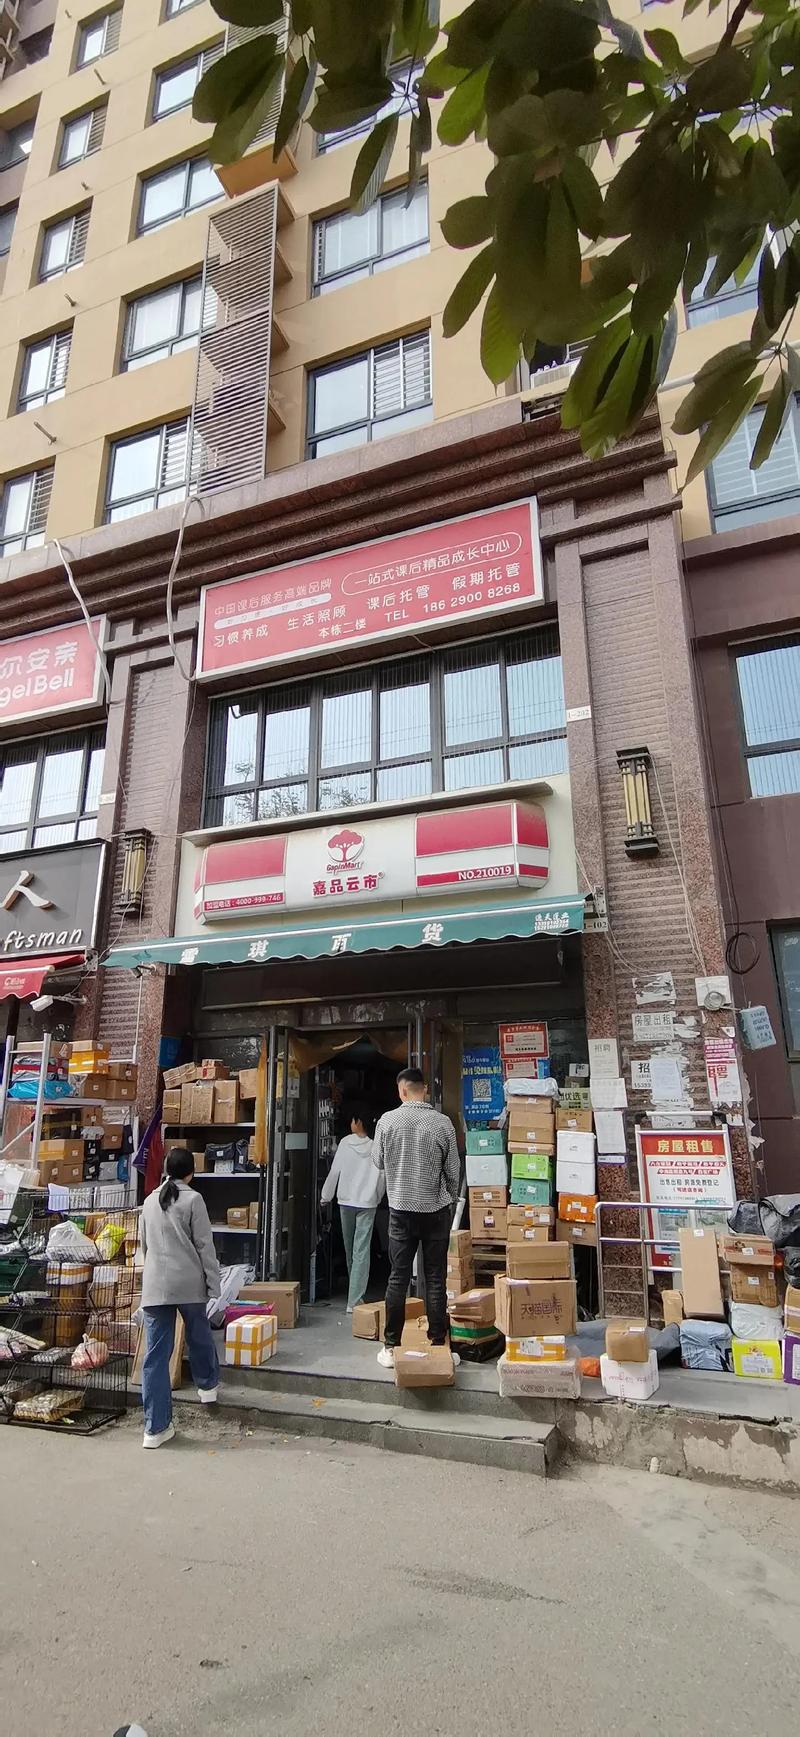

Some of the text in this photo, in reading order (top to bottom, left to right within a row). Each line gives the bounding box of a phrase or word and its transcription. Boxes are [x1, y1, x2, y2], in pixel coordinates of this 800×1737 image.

[354, 539, 510, 586] 一站式课后精品成长中心
[214, 562, 521, 648] 习惯养成 生活照顾 课后托管 假期托管
[319, 583, 521, 639] 本栋二楼 TEL 186 2900 8268
[458, 865, 512, 881] NO.210019
[312, 874, 378, 896] 嘉品云市
[635, 1013, 671, 1026] 房屋出租
[657, 1140, 714, 1153] 房屋租售
